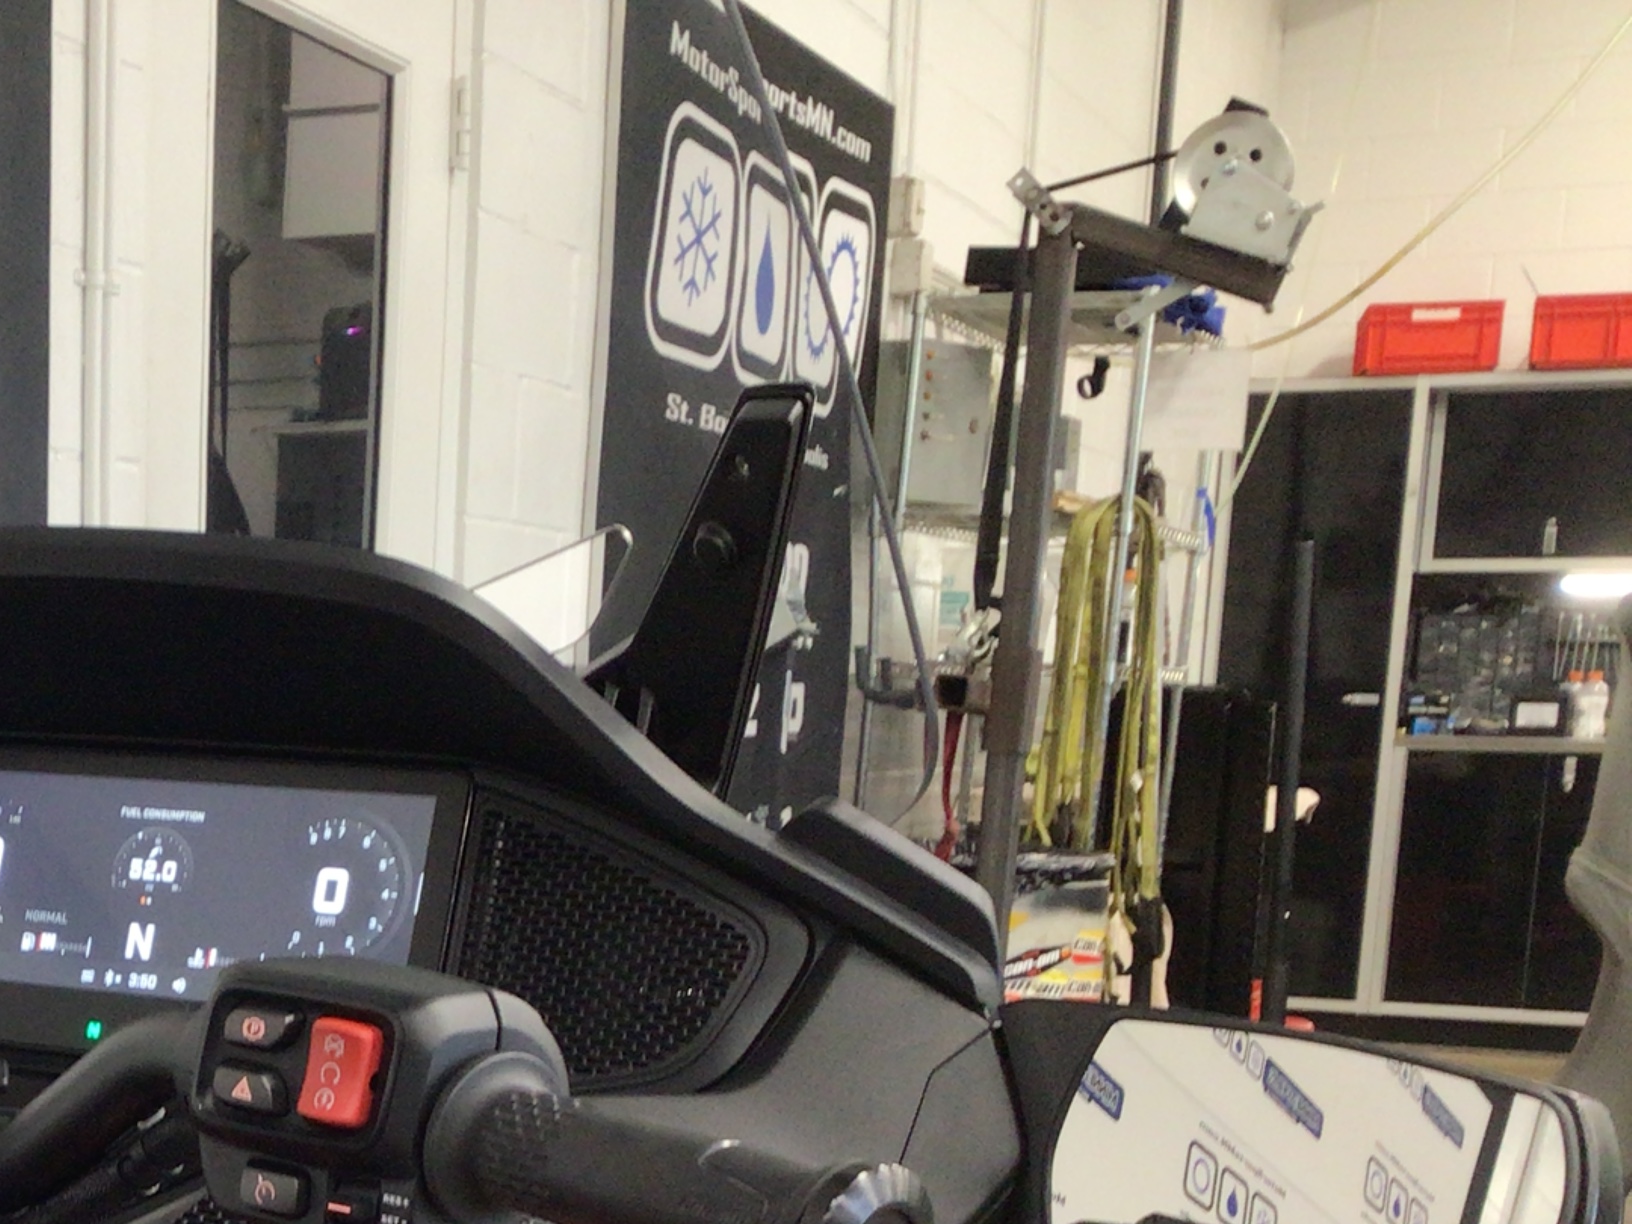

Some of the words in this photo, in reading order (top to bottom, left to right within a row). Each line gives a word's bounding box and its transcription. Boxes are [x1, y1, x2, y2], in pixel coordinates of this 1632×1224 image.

[665, 392, 694, 426] St.
[120, 805, 142, 820] FUEL
[143, 807, 206, 823] CONSUMPTION
[312, 866, 350, 915] 0
[24, 908, 67, 925] NORMAL
[124, 921, 156, 962] N
